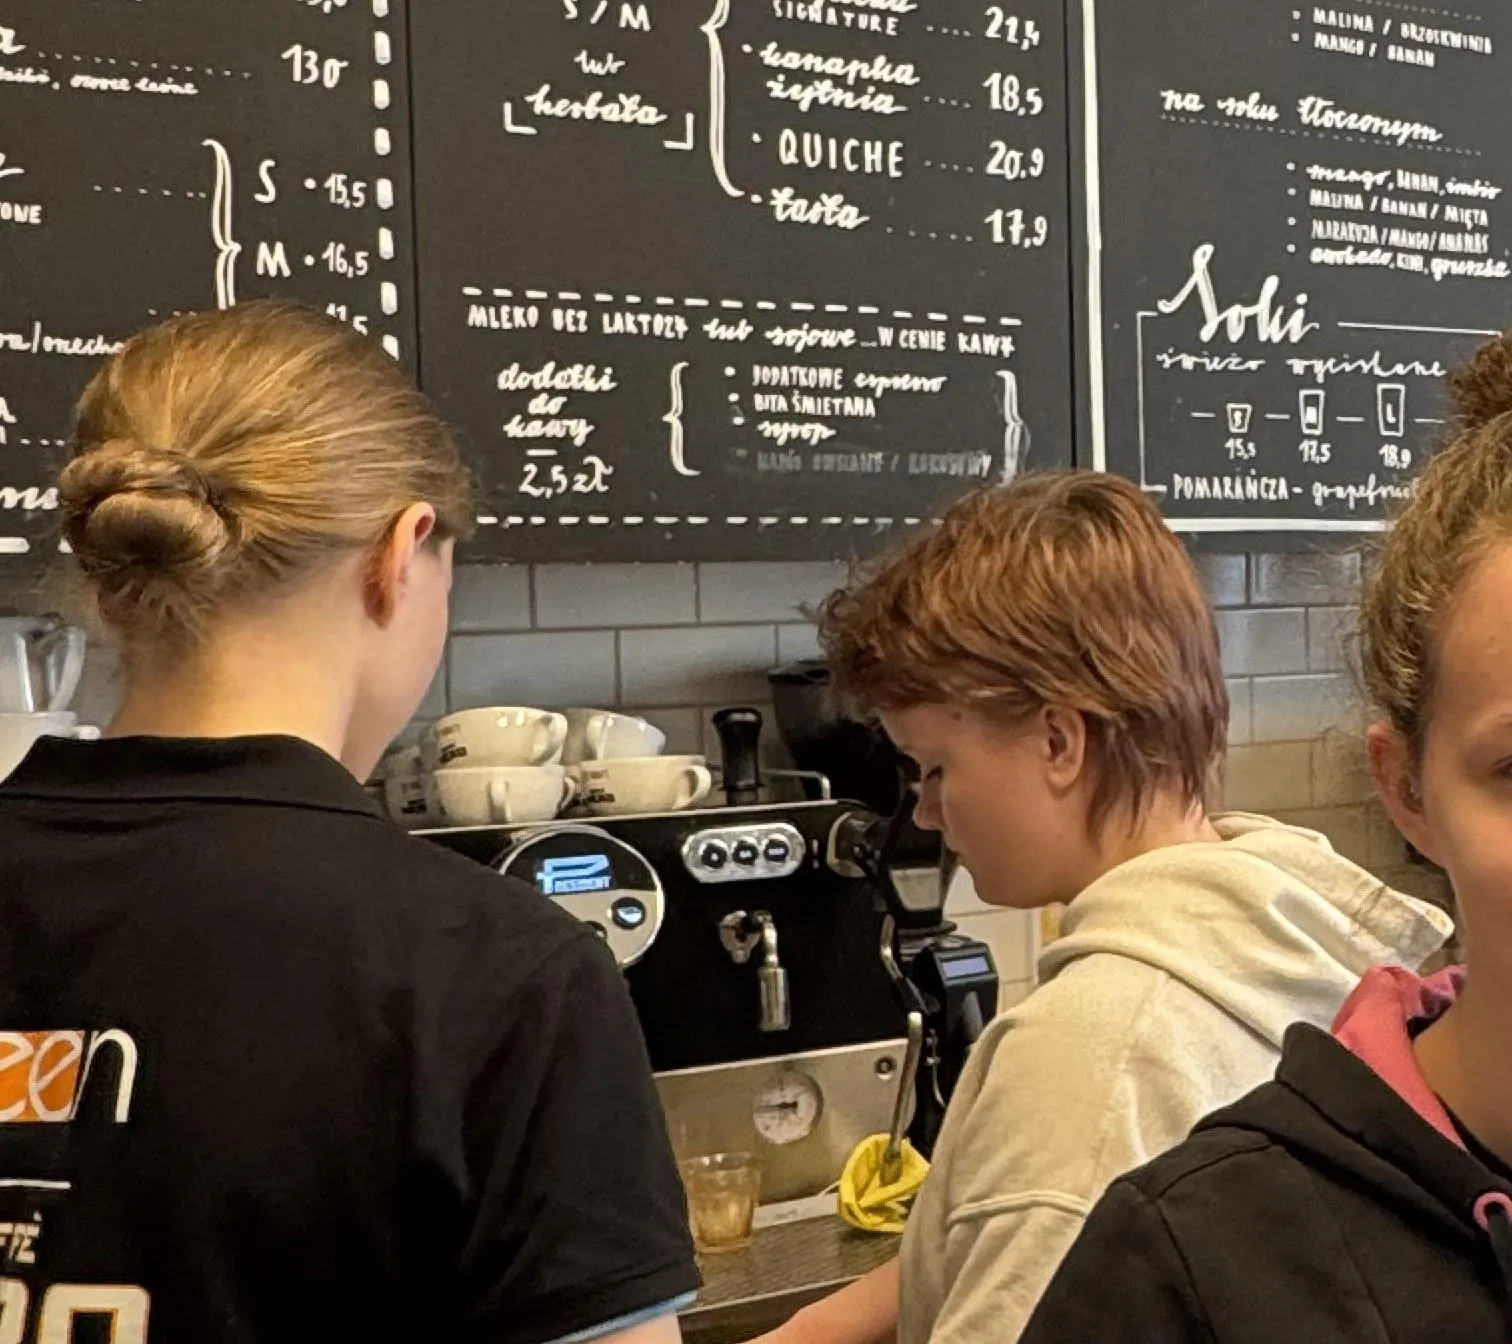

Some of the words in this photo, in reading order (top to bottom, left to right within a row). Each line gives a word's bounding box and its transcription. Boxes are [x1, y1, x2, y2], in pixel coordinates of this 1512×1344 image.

[772, 0, 900, 36] SIGNATURE
[984, 6, 1040, 51] 21,4
[1313, 7, 1374, 33] MALINA
[574, 49, 626, 76] lub
[759, 41, 921, 85] kanapka
[524, 83, 668, 125] herbata
[766, 75, 909, 116] żytnia
[1160, 89, 1205, 112] na
[1216, 92, 1280, 122] soku
[778, 129, 904, 178] QUICHE
[254, 159, 276, 204] S
[322, 172, 368, 210] 15,5
[984, 208, 1048, 249] 17,9
[256, 240, 292, 278] M
[321, 241, 370, 278] 16,5
[1156, 243, 1320, 344] Soki
[467, 304, 539, 330] MLEKO
[552, 308, 588, 333] BEZ
[602, 311, 689, 340] LAKTOZY
[898, 328, 946, 352] CENIE
[957, 332, 1016, 358] KAWY
[497, 360, 618, 392] dodatki
[752, 364, 844, 390] DODATKOWE
[1286, 350, 1448, 384] wyciskane
[791, 389, 876, 418] ŚMIETANA
[502, 414, 595, 447] kawy
